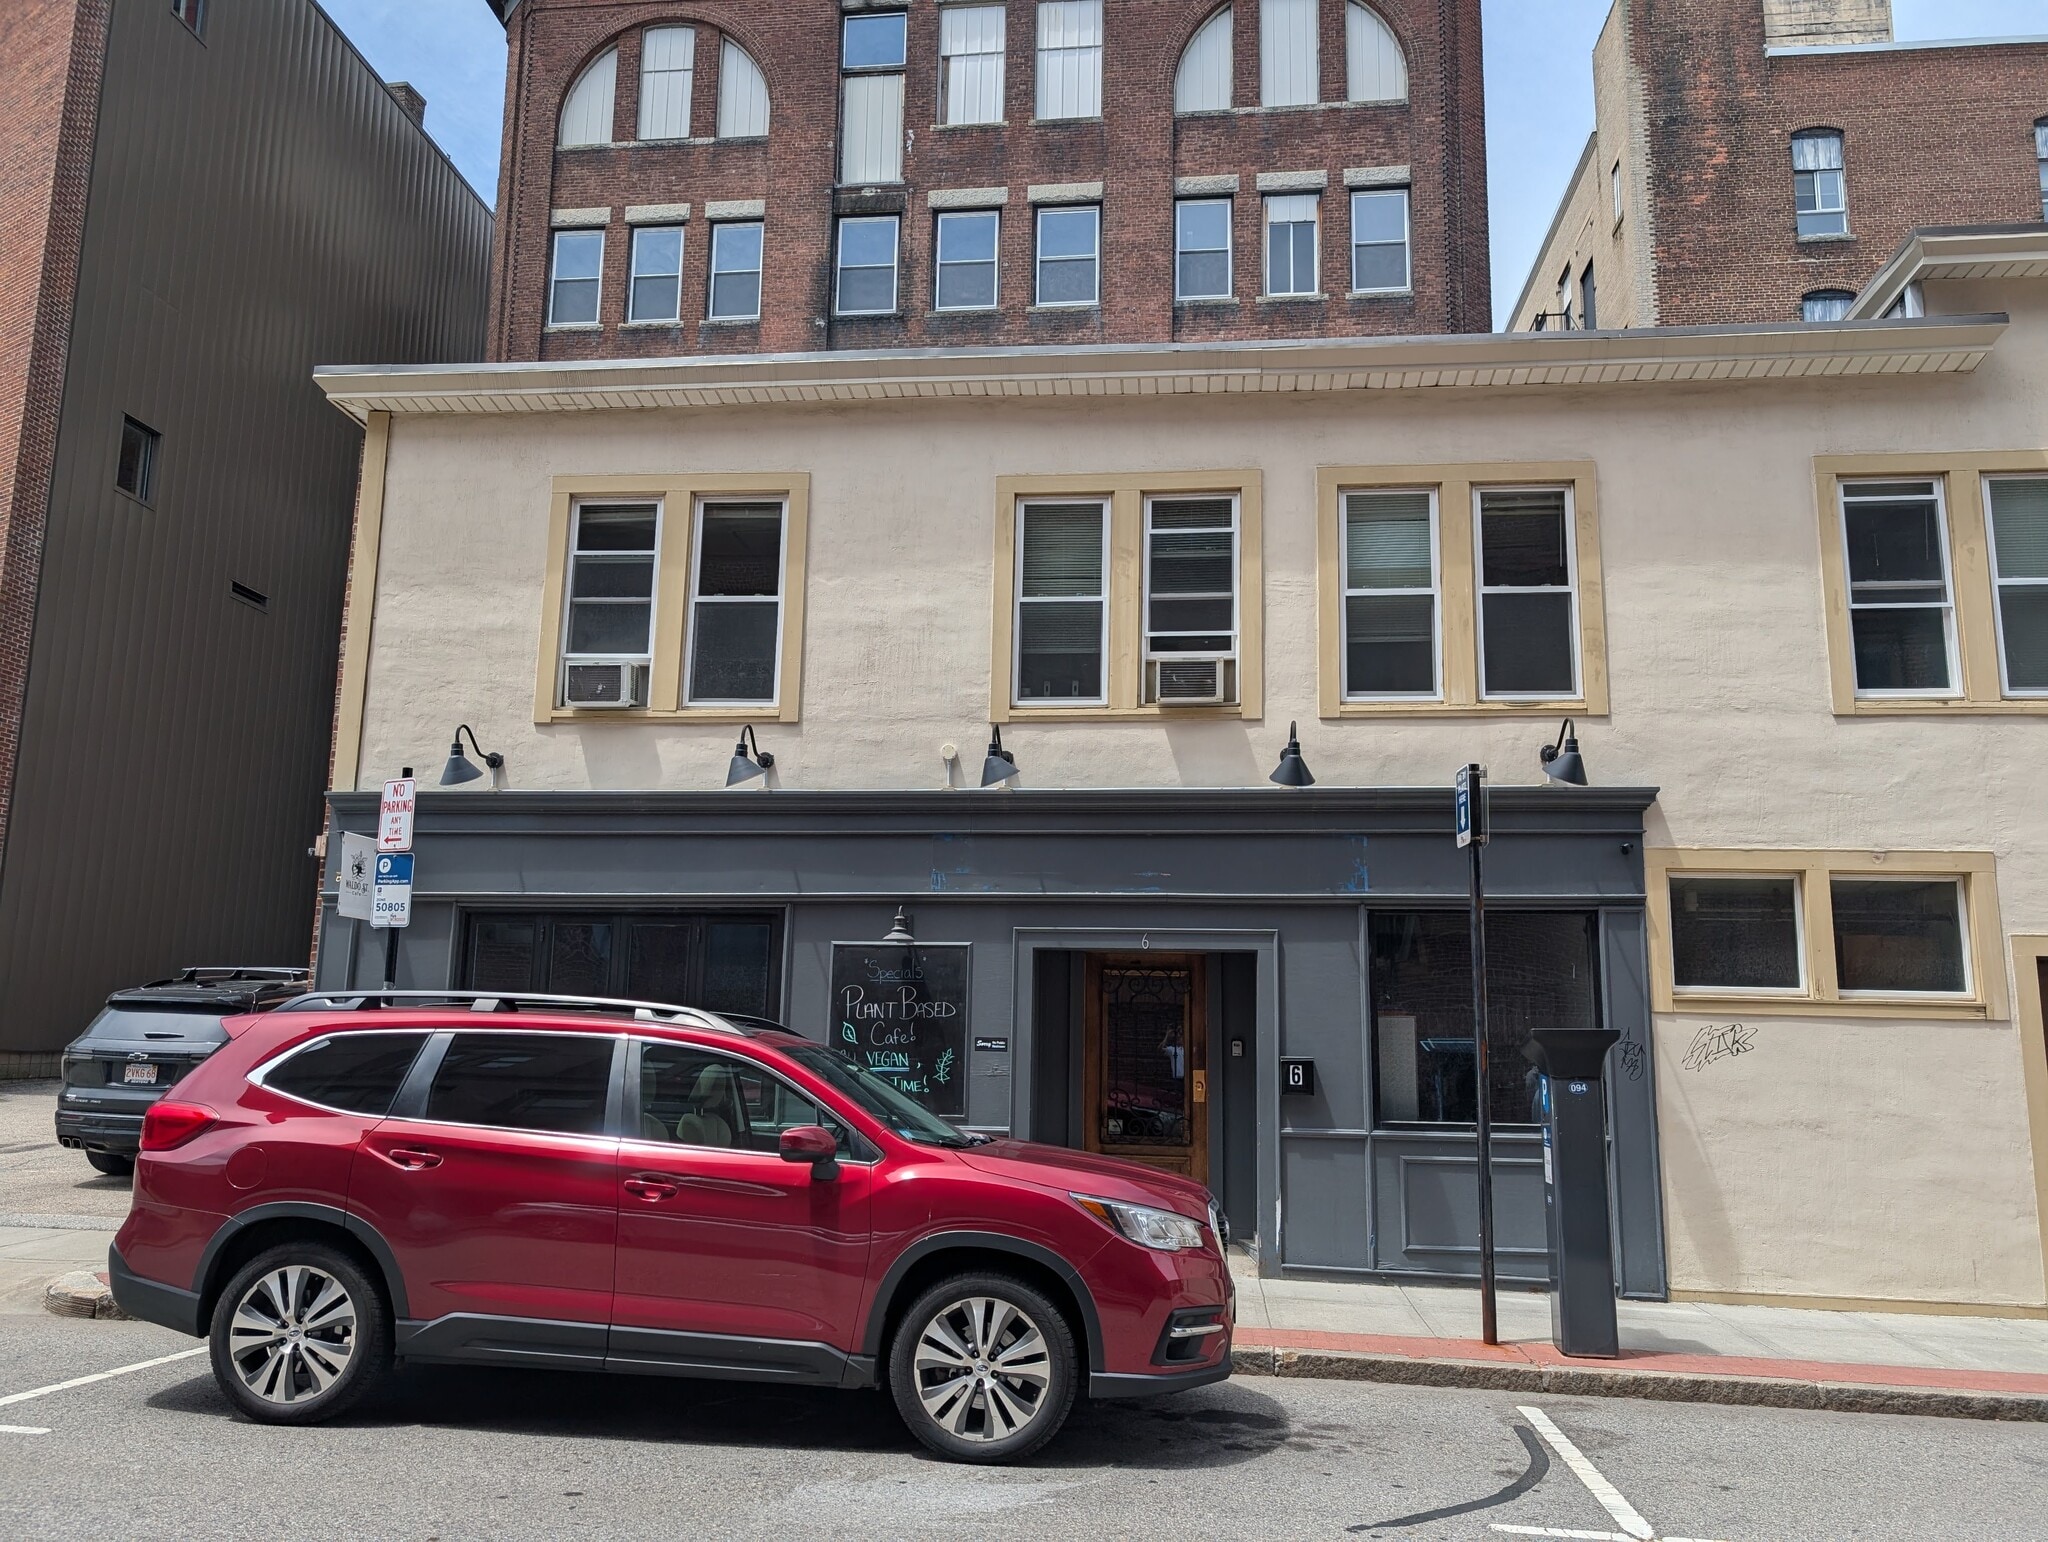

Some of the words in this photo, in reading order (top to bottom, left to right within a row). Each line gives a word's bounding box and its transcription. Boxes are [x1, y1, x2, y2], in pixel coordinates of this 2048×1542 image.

[393, 783, 405, 798] NO
[382, 799, 413, 814] PARKING
[391, 816, 402, 825] ANY
[389, 827, 402, 836] TIME
[345, 880, 361, 891] WALDO
[375, 902, 406, 912] 50805
[1141, 932, 1149, 949] 6
[840, 985, 898, 1019] PLANT
[897, 985, 957, 1021] BASED
[870, 1021, 917, 1047] Cafe!
[126, 1067, 145, 1078] 2VKG
[1291, 1065, 1301, 1084] 6
[890, 1075, 930, 1093] TIME!
[1570, 1083, 1587, 1092] 094
